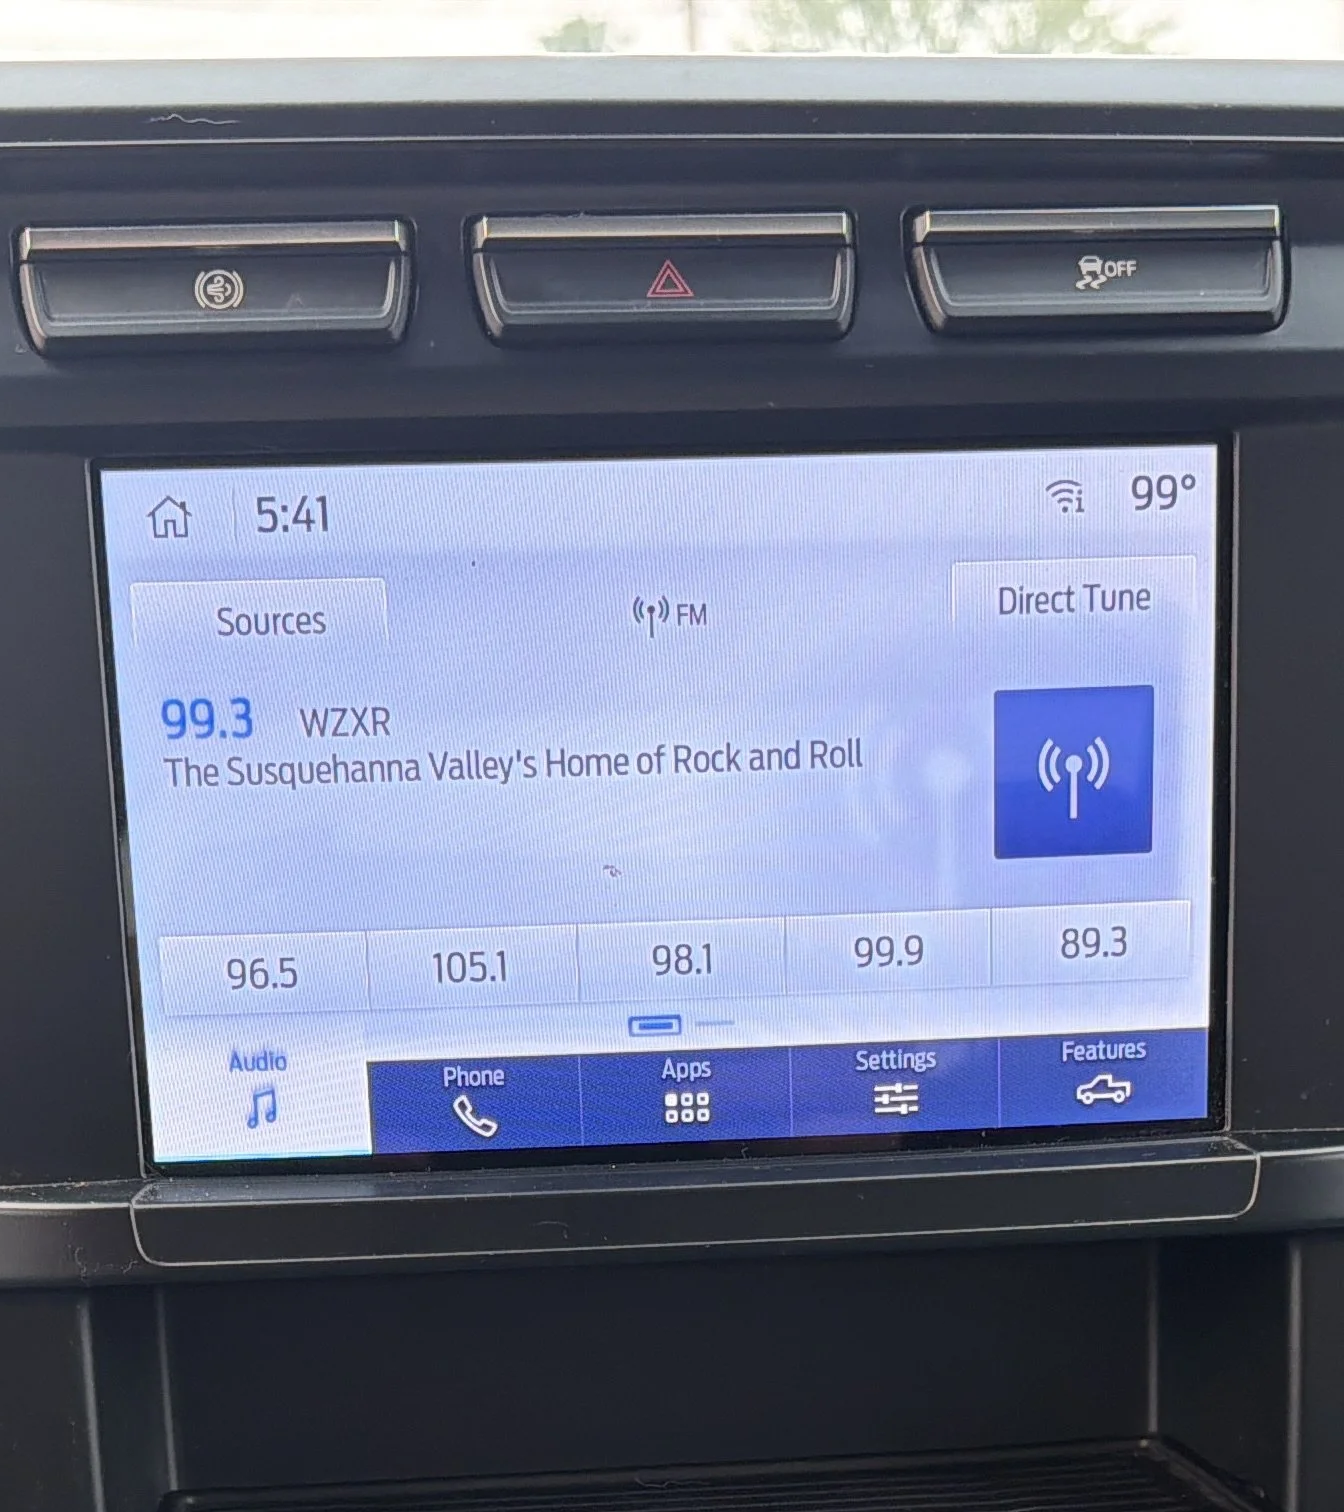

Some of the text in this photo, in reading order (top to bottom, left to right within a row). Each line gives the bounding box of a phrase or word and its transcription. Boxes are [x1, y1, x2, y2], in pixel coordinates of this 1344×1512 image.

[1104, 260, 1137, 278] OFF
[1131, 474, 1196, 511] 99°
[256, 495, 330, 533] 5:41
[676, 603, 708, 627] FM
[998, 583, 1152, 616] Direct Tune
[216, 606, 327, 637] Sources
[161, 697, 392, 740] 99.3 WZXR
[163, 737, 863, 790] The Susquehanna Valley's Home of Rock and Roll
[853, 934, 925, 969] 99.9
[1060, 925, 1128, 960] 89.3
[226, 957, 298, 991] 96.5
[432, 950, 508, 984] 105.1
[651, 942, 713, 977] 98.1
[228, 1048, 287, 1074] Audio
[855, 1047, 937, 1075] Settings
[1061, 1039, 1147, 1063] Features
[442, 1064, 506, 1089] Phone
[661, 1057, 712, 1083] Apps
